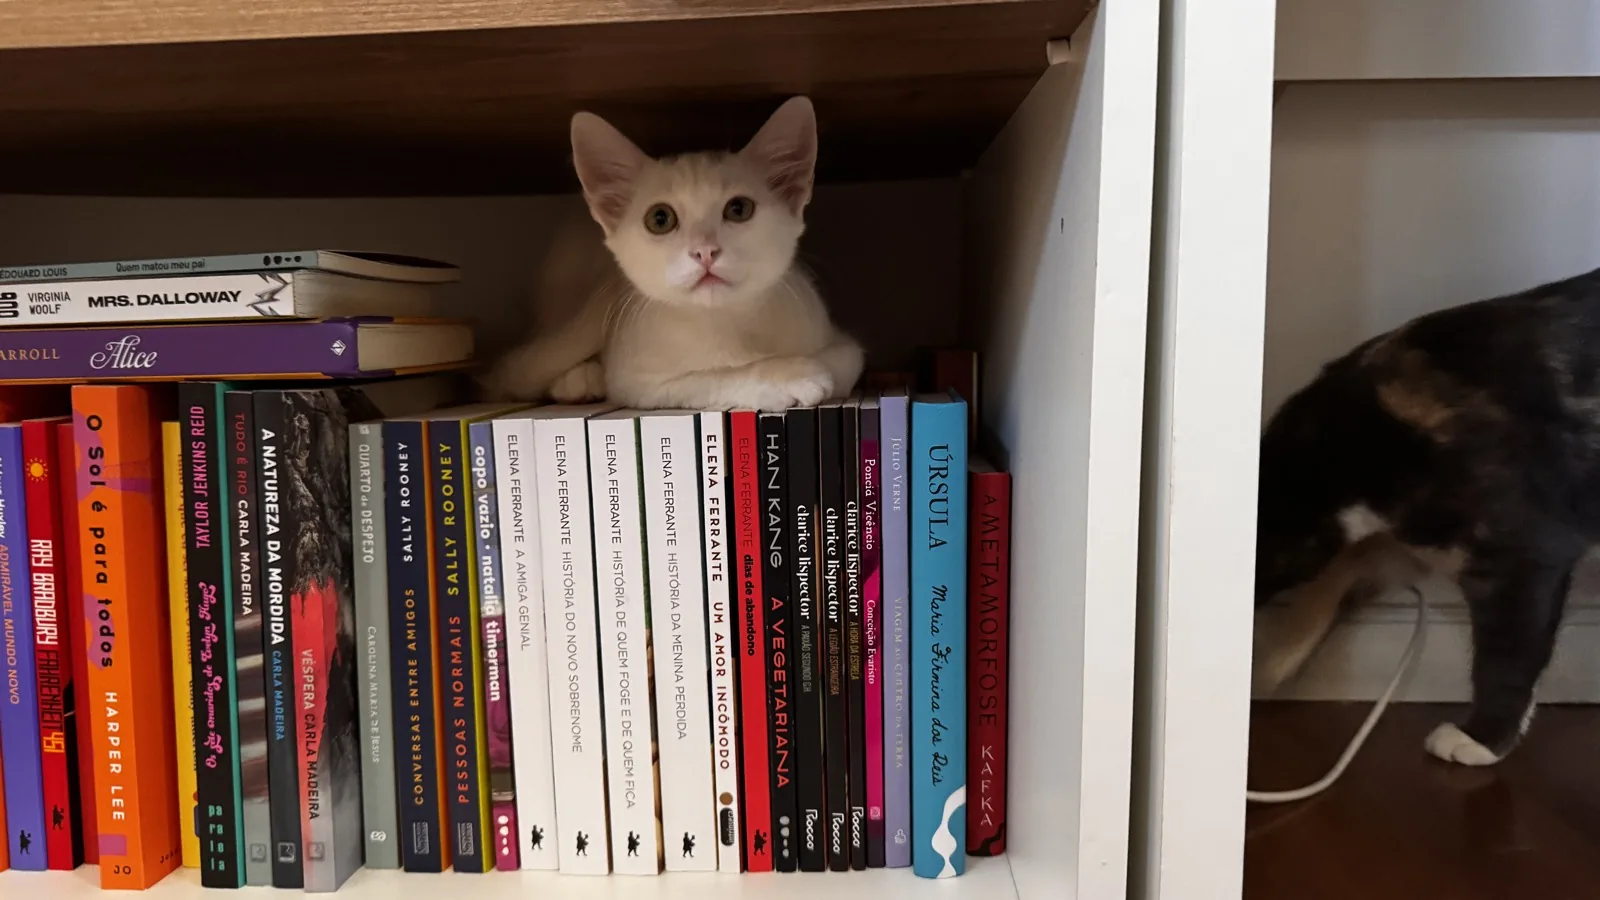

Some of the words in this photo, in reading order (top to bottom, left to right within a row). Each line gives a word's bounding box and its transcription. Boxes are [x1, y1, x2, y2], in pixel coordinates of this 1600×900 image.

[42, 267, 68, 278] LOUIS
[116, 260, 139, 273] Quem
[141, 261, 169, 271] matou
[172, 262, 188, 270] meu
[190, 258, 206, 272] pai
[28, 291, 71, 303] VIRGINIA
[29, 304, 62, 315] WOOLF
[88, 295, 133, 308] MRS.
[136, 290, 242, 306] DALLOWAY
[90, 334, 158, 370] Alice
[86, 415, 102, 431] O
[190, 406, 206, 436] REID
[235, 414, 246, 452] TUDO
[262, 428, 276, 441] A
[88, 445, 106, 487] Sol
[192, 440, 209, 498] JENKINS
[236, 457, 248, 465] É
[359, 444, 372, 493] QUARTO
[398, 442, 411, 508] ROONEY
[472, 446, 488, 488] copo
[508, 434, 520, 476] ELENA
[555, 435, 567, 477] ELENA
[606, 434, 617, 476] ELENA
[660, 437, 672, 479] ELENA
[707, 434, 718, 488] ELENA
[739, 438, 750, 480] ELENA
[766, 434, 780, 490] HAN
[865, 458, 876, 496] Ponciá
[238, 470, 248, 496] RIO
[262, 445, 280, 536] NATUREZA
[440, 443, 455, 526] ROONEY
[892, 475, 902, 512] VERNE
[928, 444, 954, 550] ÚRSULA
[984, 494, 998, 506] A
[92, 500, 108, 512] é
[195, 501, 211, 548] TAYLOR
[238, 500, 250, 548] CARLA
[476, 494, 494, 539] vazio
[510, 480, 524, 543] FERRANTE
[558, 481, 572, 545] FERRANTE
[608, 480, 622, 544] FERRANTE
[664, 482, 677, 546] FERRANTE
[742, 482, 753, 548] FERRANTE
[797, 504, 811, 553] clarice
[847, 501, 860, 550] clarice
[866, 501, 878, 550] Vicêncio
[30, 539, 53, 568] RAY
[267, 540, 282, 563] DA
[362, 510, 374, 564] DESPEJO
[402, 516, 413, 562] SALLY
[516, 550, 525, 559] A
[709, 498, 722, 582] FERRANTE
[768, 498, 782, 568] KANG
[826, 508, 840, 556] clarice
[89, 527, 108, 584] para
[446, 538, 460, 596] SALLY
[744, 554, 754, 578] dias
[0, 544, 14, 616] ADMIRÁVEL
[199, 582, 217, 621] Hugo
[240, 552, 253, 616] MADEIRA
[482, 555, 502, 616] natalia
[516, 562, 528, 603] AMIGA
[562, 551, 575, 609] HISTÓRIA
[612, 550, 626, 608] HISTÓRIA
[668, 553, 681, 610] HISTÓRIA
[744, 580, 754, 596] de
[796, 556, 812, 620] lispector
[824, 560, 840, 622] lispector
[847, 554, 860, 616] lispector
[33, 572, 58, 646] BRADBURY
[268, 568, 286, 645] MORDIDA
[405, 589, 417, 650] AMIGOS
[565, 612, 576, 631] DO
[616, 611, 627, 628] DE
[671, 614, 682, 632] DA
[713, 602, 724, 624] UM
[772, 597, 784, 610] A
[864, 600, 876, 646] Conceição
[894, 596, 903, 643] VIAGEM
[930, 585, 948, 636] Maria
[979, 512, 1000, 727] METAMORFOSE
[4, 619, 17, 667] MUNDO
[97, 598, 116, 668] todos
[201, 623, 219, 662] Evelyn
[518, 606, 531, 651] GENIAL
[745, 598, 756, 656] abandono
[801, 630, 812, 651] PAIXÃO
[829, 634, 840, 654] LEGIÃO
[850, 628, 858, 644] HORA
[850, 645, 859, 654] DA
[202, 665, 214, 677] de
[272, 650, 282, 688] CARLA
[368, 626, 377, 679] CAROLINA
[450, 616, 464, 708] NORMAIS
[485, 620, 502, 702] timerman
[566, 634, 578, 671] NOVO
[617, 632, 628, 668] QUEM
[672, 635, 684, 682] MENINA
[714, 632, 726, 677] AMOR
[802, 652, 812, 680] SEGUNDO
[850, 655, 860, 680] ESTRELA
[867, 648, 876, 684] Evaristo
[9, 670, 20, 705] NOVO
[38, 652, 65, 732] FAHRENHEIT
[301, 649, 316, 710] VÉSPERA
[408, 659, 420, 706] ENTRE
[620, 670, 631, 706] FOGE
[830, 656, 840, 696] ESTRANGEIRA
[894, 664, 904, 711] CENTRO
[931, 642, 952, 713] Firmina
[202, 676, 223, 729] maridos
[274, 690, 286, 740] MADEIRA
[368, 682, 378, 718] MARIA
[568, 674, 582, 754] SOBRENOME
[675, 686, 687, 740] PERDIDA
[772, 619, 790, 788] VEGETARIANA
[43, 732, 65, 753] 451
[105, 692, 122, 774] HARPER
[304, 714, 317, 758] CARLA
[370, 735, 380, 764] JESUS
[622, 720, 632, 737] DE
[717, 686, 730, 770] INCÔMODO
[895, 732, 904, 768] TERRA
[932, 716, 948, 747] dos
[206, 754, 217, 768] Os
[410, 714, 424, 806] CONVERSAS
[454, 718, 468, 804] PESSOAS
[622, 740, 634, 777] QUEM
[932, 752, 949, 787] Reis
[111, 786, 125, 820] LEE
[306, 760, 320, 820] MADEIRA
[625, 780, 636, 809] FICA
[980, 745, 995, 827] KAFKA
[805, 808, 818, 850] Rocco
[832, 812, 844, 854] Rocco
[852, 806, 864, 848] Rocco
[114, 864, 132, 876] JO
